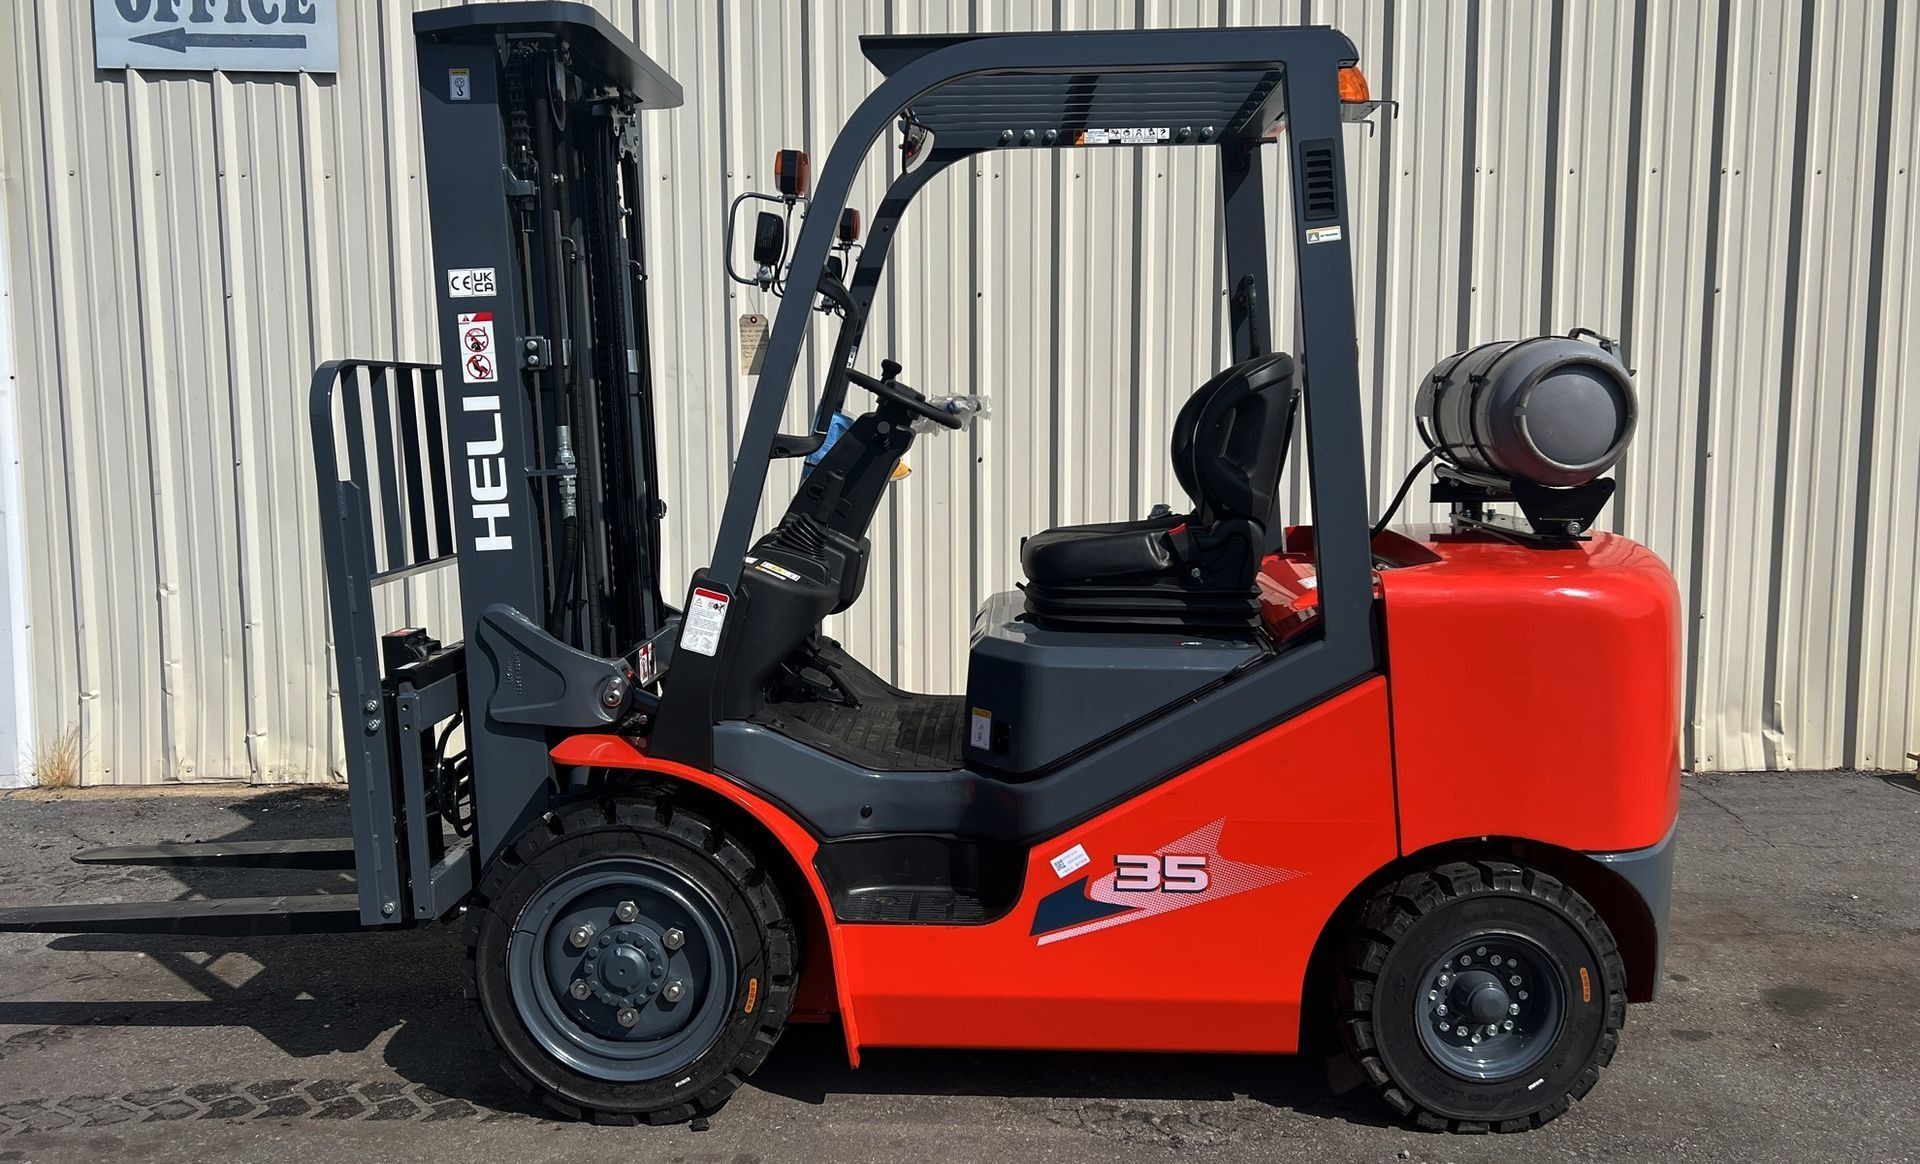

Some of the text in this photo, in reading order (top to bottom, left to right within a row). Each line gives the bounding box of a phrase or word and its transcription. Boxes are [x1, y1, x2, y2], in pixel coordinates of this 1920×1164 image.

[451, 276, 471, 290] CE
[473, 272, 492, 282] UK
[475, 283, 494, 292] CA
[462, 395, 513, 551] HELI
[1113, 854, 1208, 893] 35
